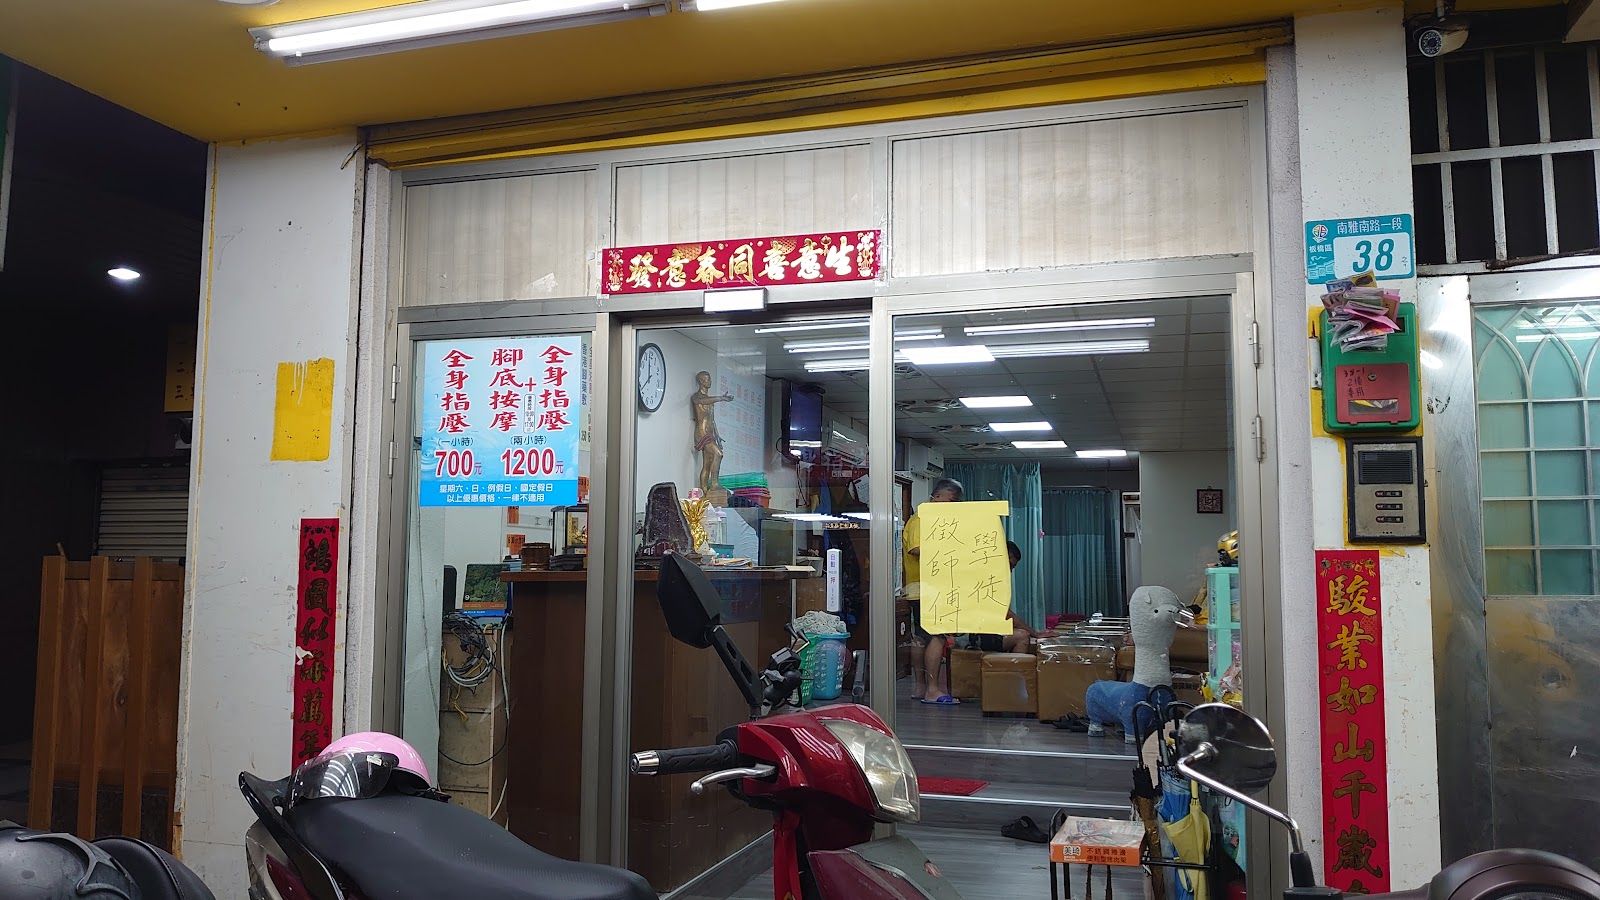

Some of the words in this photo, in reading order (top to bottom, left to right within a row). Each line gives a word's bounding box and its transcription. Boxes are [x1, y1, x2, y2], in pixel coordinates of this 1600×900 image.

[1309, 244, 1333, 253] 板橋區
[1337, 217, 1402, 234] 南雅南路一段
[1352, 238, 1395, 273] 38
[437, 349, 474, 433] 全身指壓
[488, 348, 524, 432] 腳底按摩
[536, 345, 573, 431] 全身指壓
[925, 517, 965, 633] 徵師傅
[968, 531, 1007, 606] 學徒
[1325, 573, 1384, 894] 駿業如山千歲
